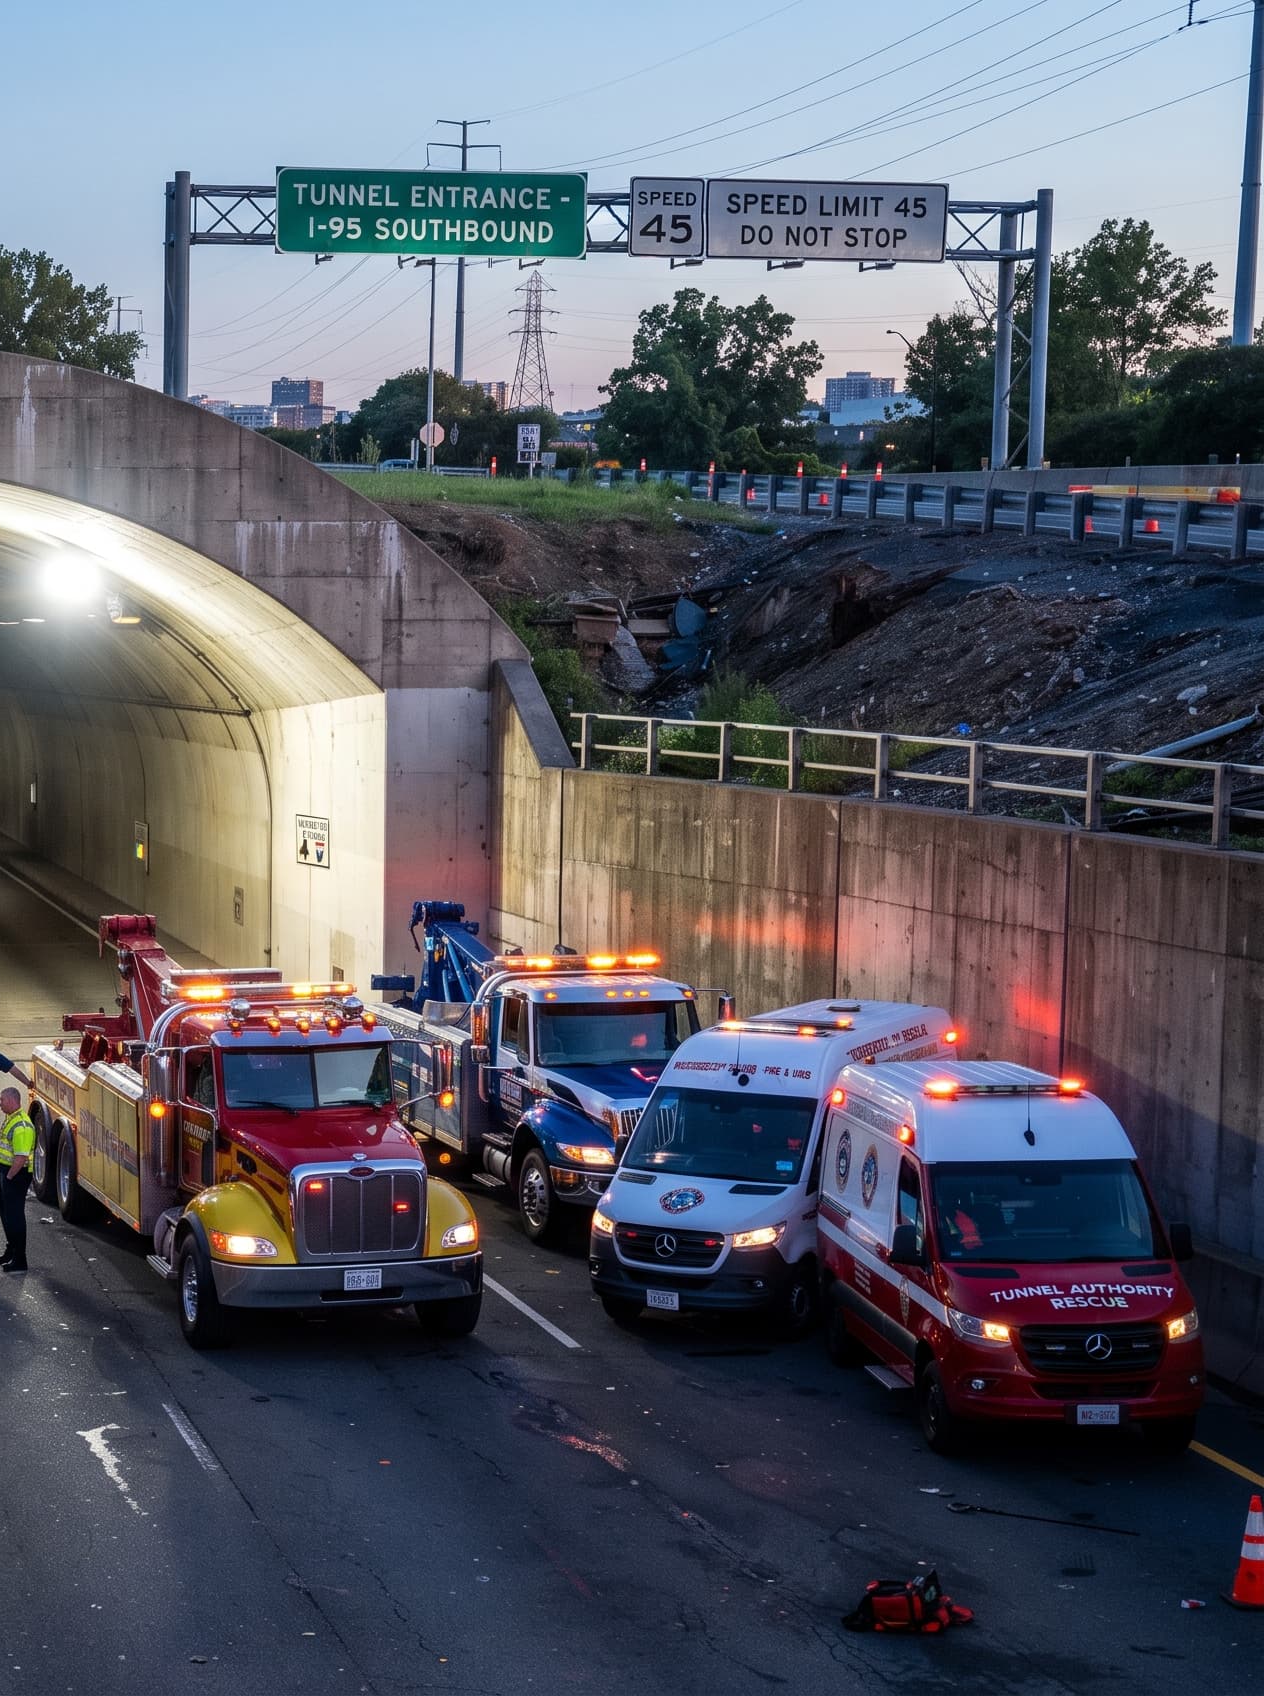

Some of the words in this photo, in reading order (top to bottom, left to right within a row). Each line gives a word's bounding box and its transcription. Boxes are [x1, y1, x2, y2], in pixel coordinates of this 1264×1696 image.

[293, 183, 399, 207] TUNNEL
[411, 185, 551, 210] ENTRANCE
[637, 191, 697, 207] SPEED
[726, 193, 807, 216] SPEED
[819, 195, 884, 217] LIMIT
[894, 197, 927, 218] 45
[308, 216, 362, 240] I-95
[374, 217, 554, 243] SOUTHBOUND
[639, 214, 693, 244] 45
[741, 225, 773, 246] DO
[785, 226, 833, 247] NOT
[844, 227, 907, 249] STOP
[990, 1284, 1064, 1303] TUNNEL
[1070, 1283, 1174, 1299] AUTHORITY
[1050, 1296, 1129, 1310] RESCUE
